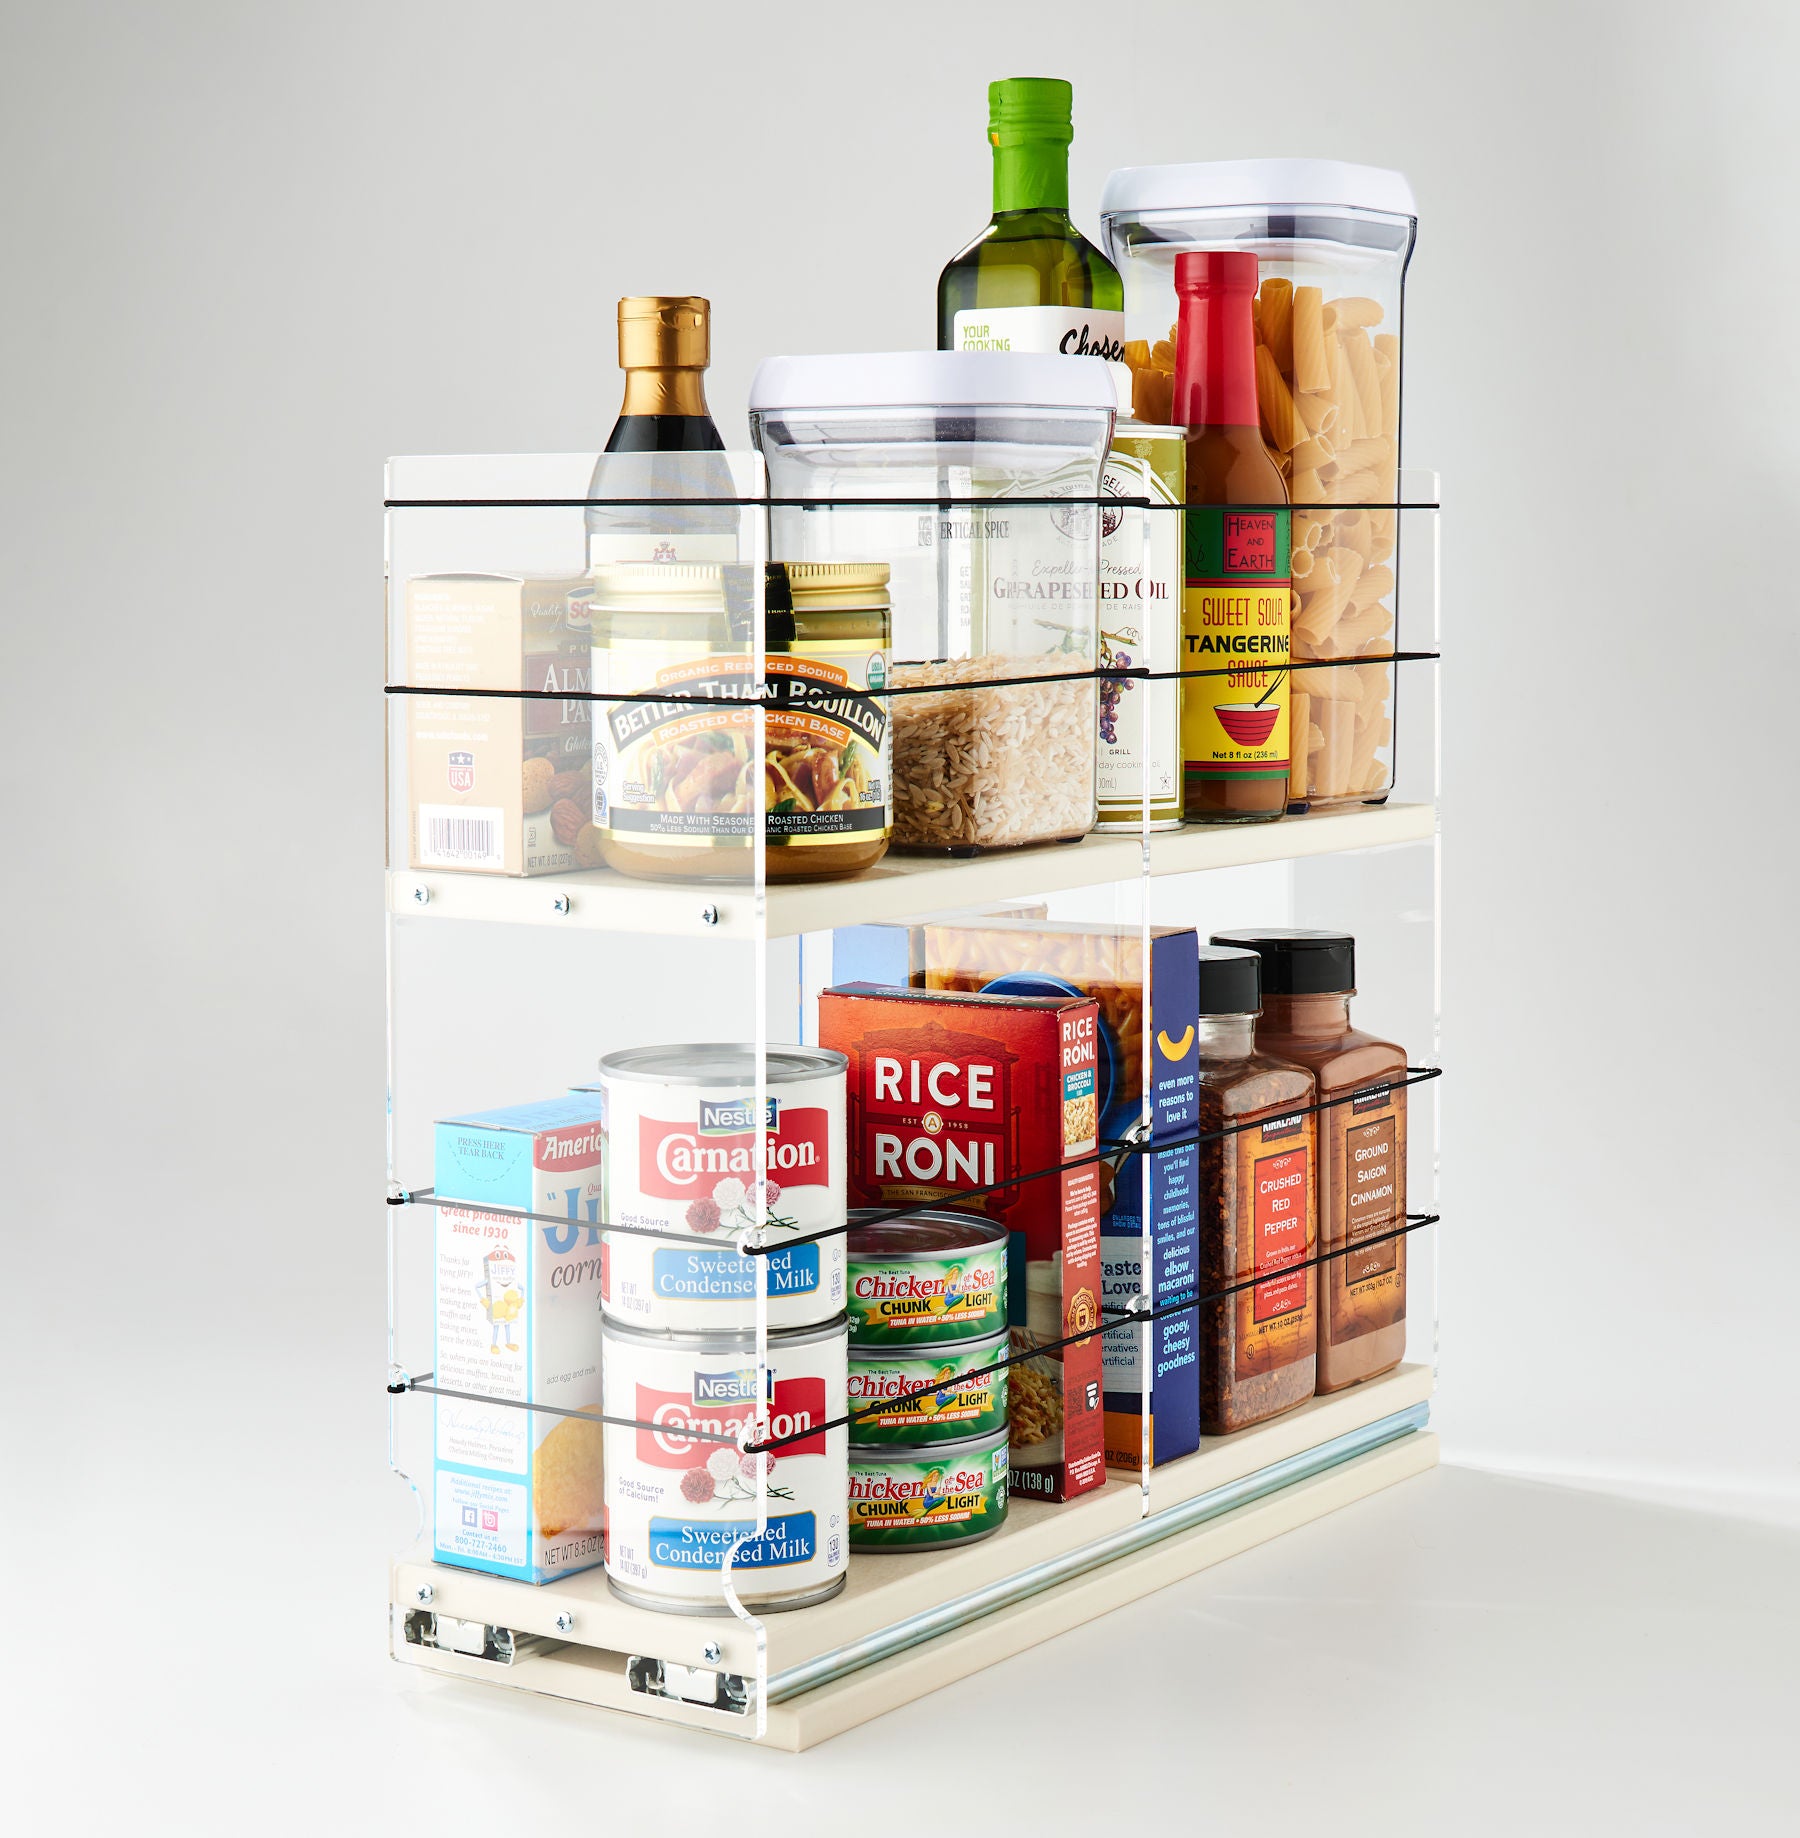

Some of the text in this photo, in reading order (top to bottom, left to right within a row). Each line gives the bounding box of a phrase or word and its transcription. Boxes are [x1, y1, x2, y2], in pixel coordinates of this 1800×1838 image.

[963, 325, 990, 338] YOUR
[963, 339, 1011, 352] COOKING
[984, 520, 1010, 539] SPICE
[1228, 517, 1274, 537] HEAVEN
[1246, 538, 1264, 546] AND
[1227, 548, 1274, 570] EARTH
[1135, 577, 1169, 600] OIL
[1202, 597, 1284, 626] SWEET SOUR
[660, 660, 844, 683] ORGANIC REDCED SODIUM
[1227, 660, 1268, 688] SAUCE
[613, 689, 694, 740] BETTER
[788, 680, 882, 742] BOUILLON
[659, 712, 845, 741] ROASTED CHCKEN BASE
[1212, 751, 1227, 759] Net
[1228, 751, 1234, 759] 8
[450, 770, 471, 787] USA
[650, 823, 853, 834] 50% LESS SODIUM THAN ROASTED CHICKEN BASE
[660, 813, 844, 827] MADE WITH SEASONE ROASTED CHICKEN
[527, 856, 537, 869] NET
[1063, 1016, 1093, 1042] RICE
[875, 1056, 995, 1110] RICE
[1066, 1071, 1088, 1084] CHICKEN
[1067, 1080, 1091, 1092] BROCCOLI
[1158, 1073, 1194, 1092] even more
[1158, 1091, 1194, 1109] reasons to
[902, 1117, 969, 1130] EST A 1958
[1166, 1108, 1188, 1124] love it
[458, 1136, 506, 1151] PRESS HERE
[1354, 1142, 1389, 1163] GROUND
[459, 1146, 504, 1161] TEAR BACK
[875, 1132, 995, 1186] RONI
[1163, 1155, 1190, 1174] you'll find
[1357, 1163, 1387, 1183] SAIGON
[1168, 1173, 1185, 1186] happy
[1260, 1173, 1302, 1194] CRUSHED
[901, 1189, 914, 1197] SAN
[1163, 1184, 1190, 1201] childhood
[1350, 1183, 1393, 1207] CINNAMON
[1272, 1198, 1290, 1213] RED
[440, 1206, 522, 1226] Great products
[639, 1216, 670, 1228] Source
[1157, 1214, 1195, 1231] tons of blissful
[453, 1221, 509, 1240] since 1930
[1264, 1217, 1298, 1237] PEPPER
[1157, 1227, 1195, 1246] smiles, and our
[1163, 1243, 1190, 1260] delicious
[490, 1263, 516, 1276] JIFFY
[1164, 1259, 1189, 1277] elbow
[775, 1272, 815, 1291] Milk
[854, 1274, 946, 1299] Chicken
[971, 1268, 996, 1290] Sea
[1102, 1280, 1141, 1295] Love
[1158, 1269, 1194, 1294] macaroni
[1159, 1289, 1193, 1307] waiting to be
[1350, 1286, 1359, 1297] NET
[879, 1292, 993, 1316] CHUNK LIGHT
[889, 1315, 937, 1327] TUNA IN WATER
[1163, 1319, 1190, 1340] gooey,
[1258, 1318, 1291, 1335] NET OZ
[1163, 1337, 1190, 1355] cheesy
[1157, 1352, 1196, 1378] goodness
[870, 1391, 988, 1415] CHUNK LIGHT
[879, 1411, 960, 1426] TUNA IN WATER 50% LESS
[636, 1481, 665, 1495] Source
[848, 1471, 984, 1501] hicken Sea
[942, 1486, 954, 1496] the
[1022, 1471, 1054, 1494] (138 g)
[619, 1487, 659, 1503] of Calcium!
[856, 1494, 980, 1517] CHUNK LIGHT
[866, 1514, 950, 1528] TUNA IN WATER LESS
[454, 1535, 508, 1553] 800-727-2460
[545, 1537, 598, 1567] NET WT 8.5 OZ
[655, 1541, 763, 1564] Condensed
[770, 1537, 810, 1559] Milk
